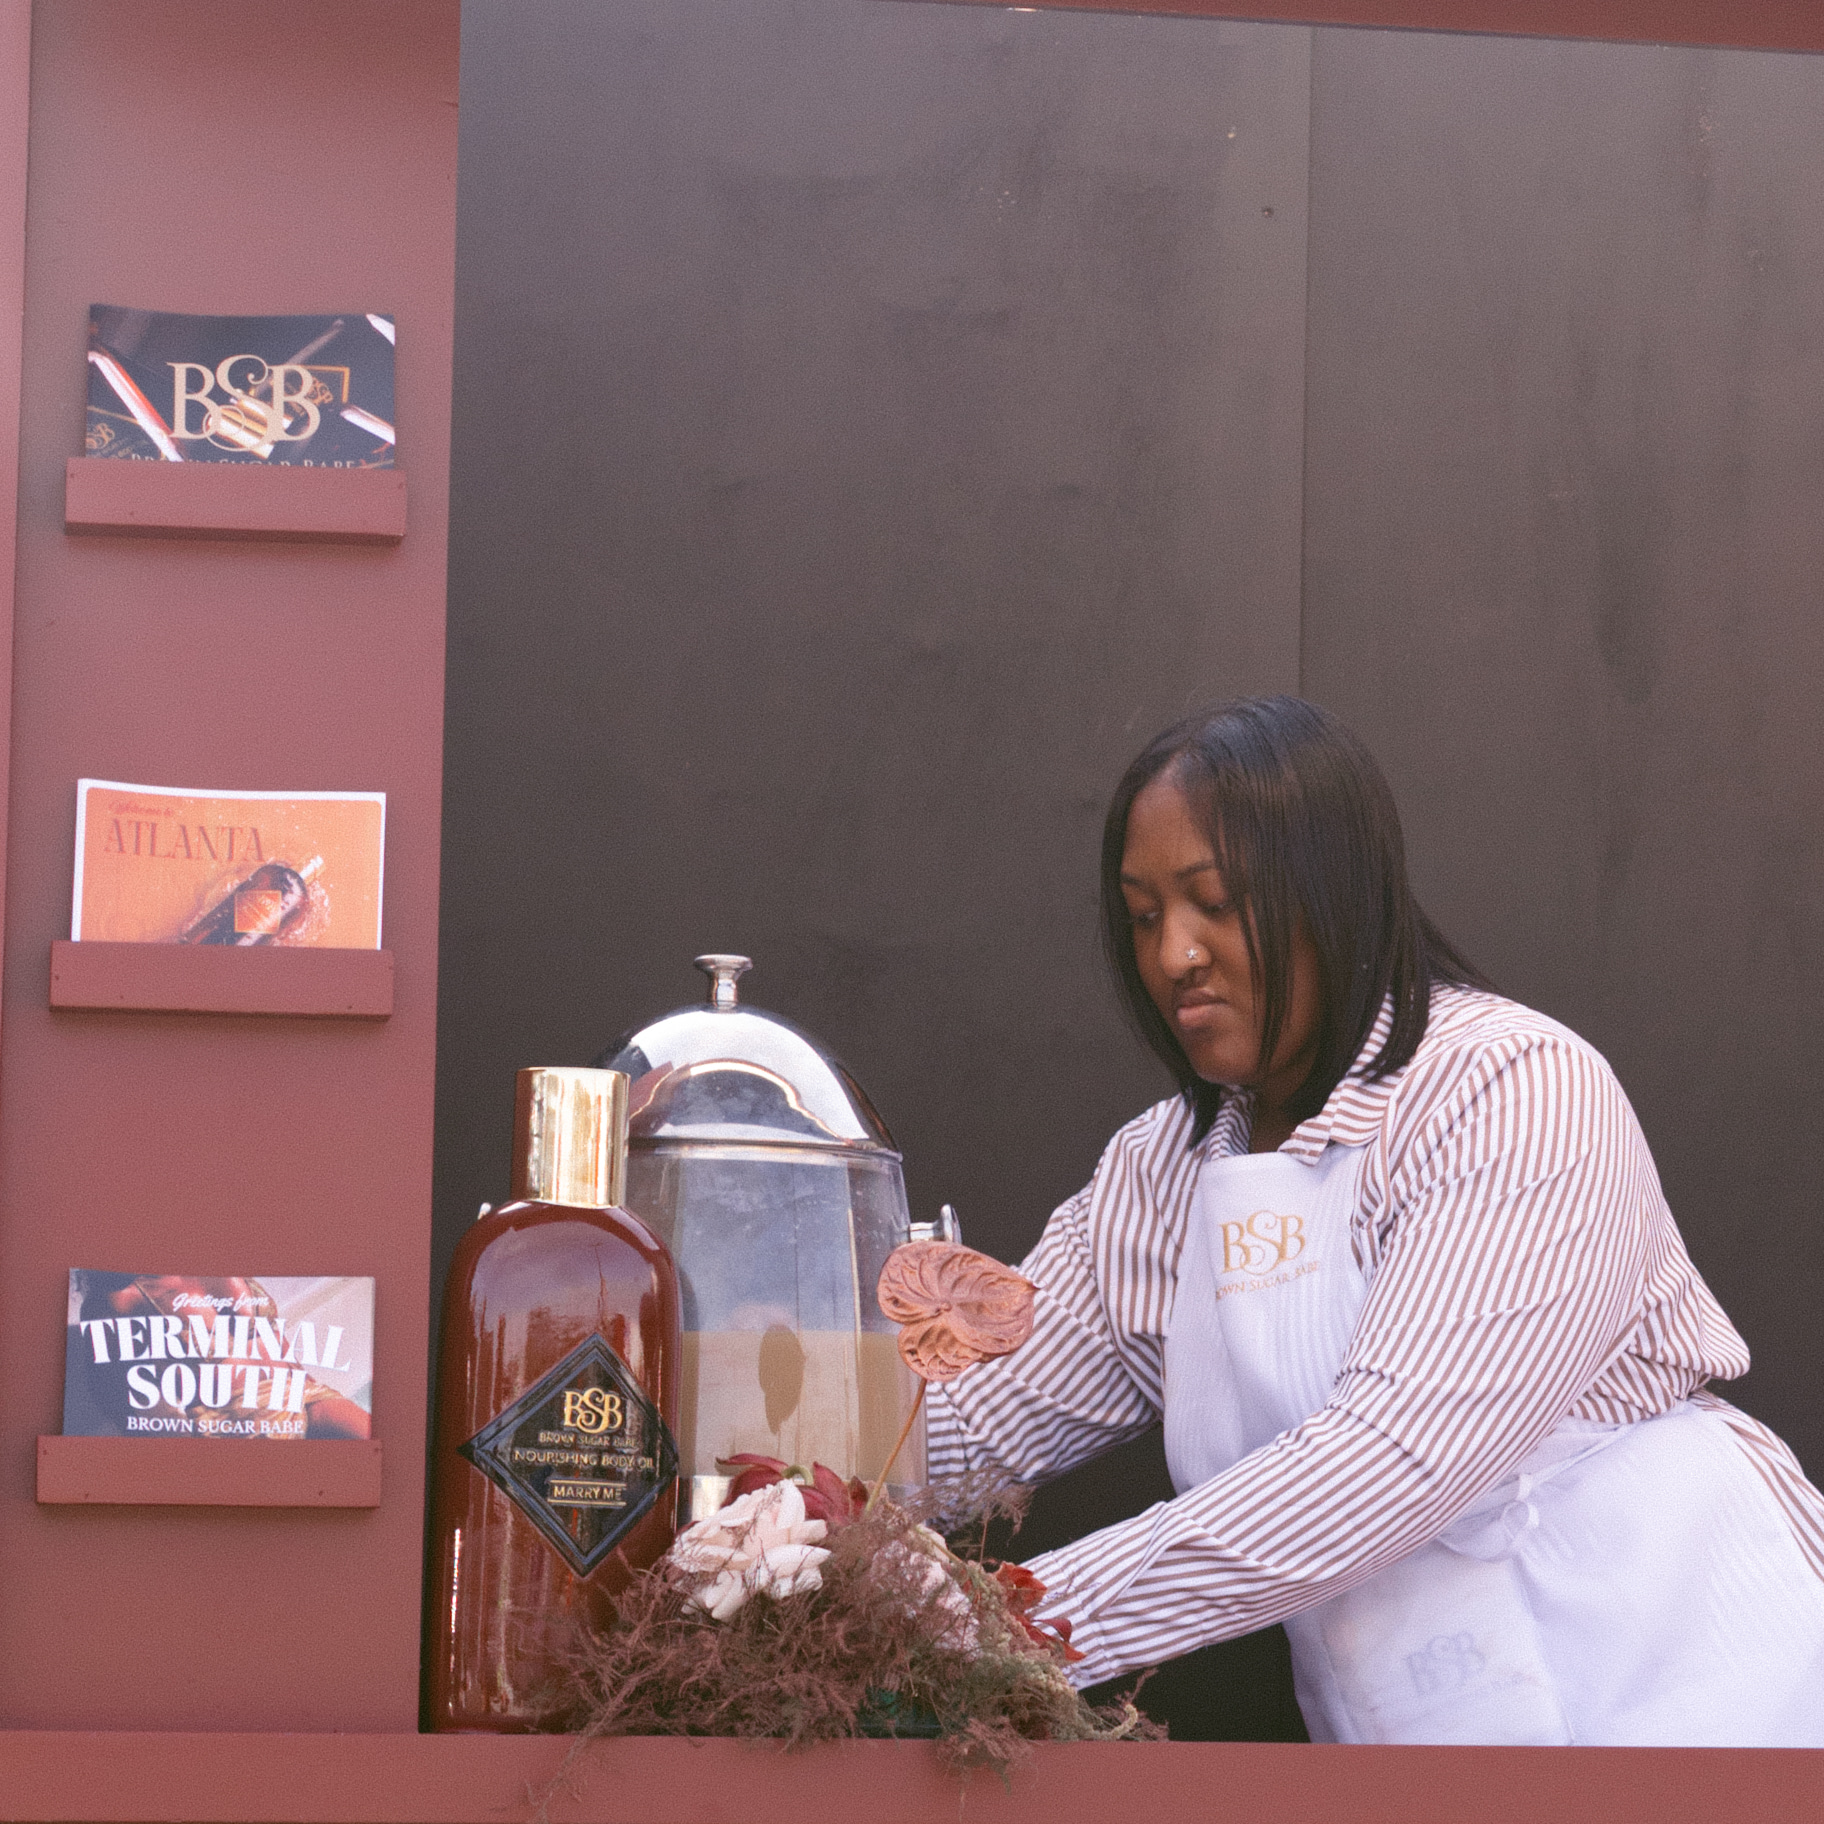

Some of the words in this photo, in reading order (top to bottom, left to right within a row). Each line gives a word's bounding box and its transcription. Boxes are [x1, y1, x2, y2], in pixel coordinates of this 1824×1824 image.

[166, 354, 320, 451] BSB
[103, 818, 266, 862] ATLANTA
[1219, 1210, 1305, 1276] BSB
[172, 1293, 232, 1312] Greetings
[80, 1314, 350, 1372] TERMINAL
[127, 1364, 307, 1414] SOUTH
[564, 1387, 622, 1433] BSB
[127, 1416, 193, 1433] BROWN
[198, 1418, 255, 1434] SUGAR
[260, 1420, 305, 1434] BABE
[539, 1433, 574, 1444] BROWN
[514, 1450, 597, 1467] NOURISHING
[602, 1455, 633, 1470] BODY
[638, 1457, 653, 1469] OIL
[554, 1485, 600, 1498] MARRY
[603, 1487, 622, 1501] ME
